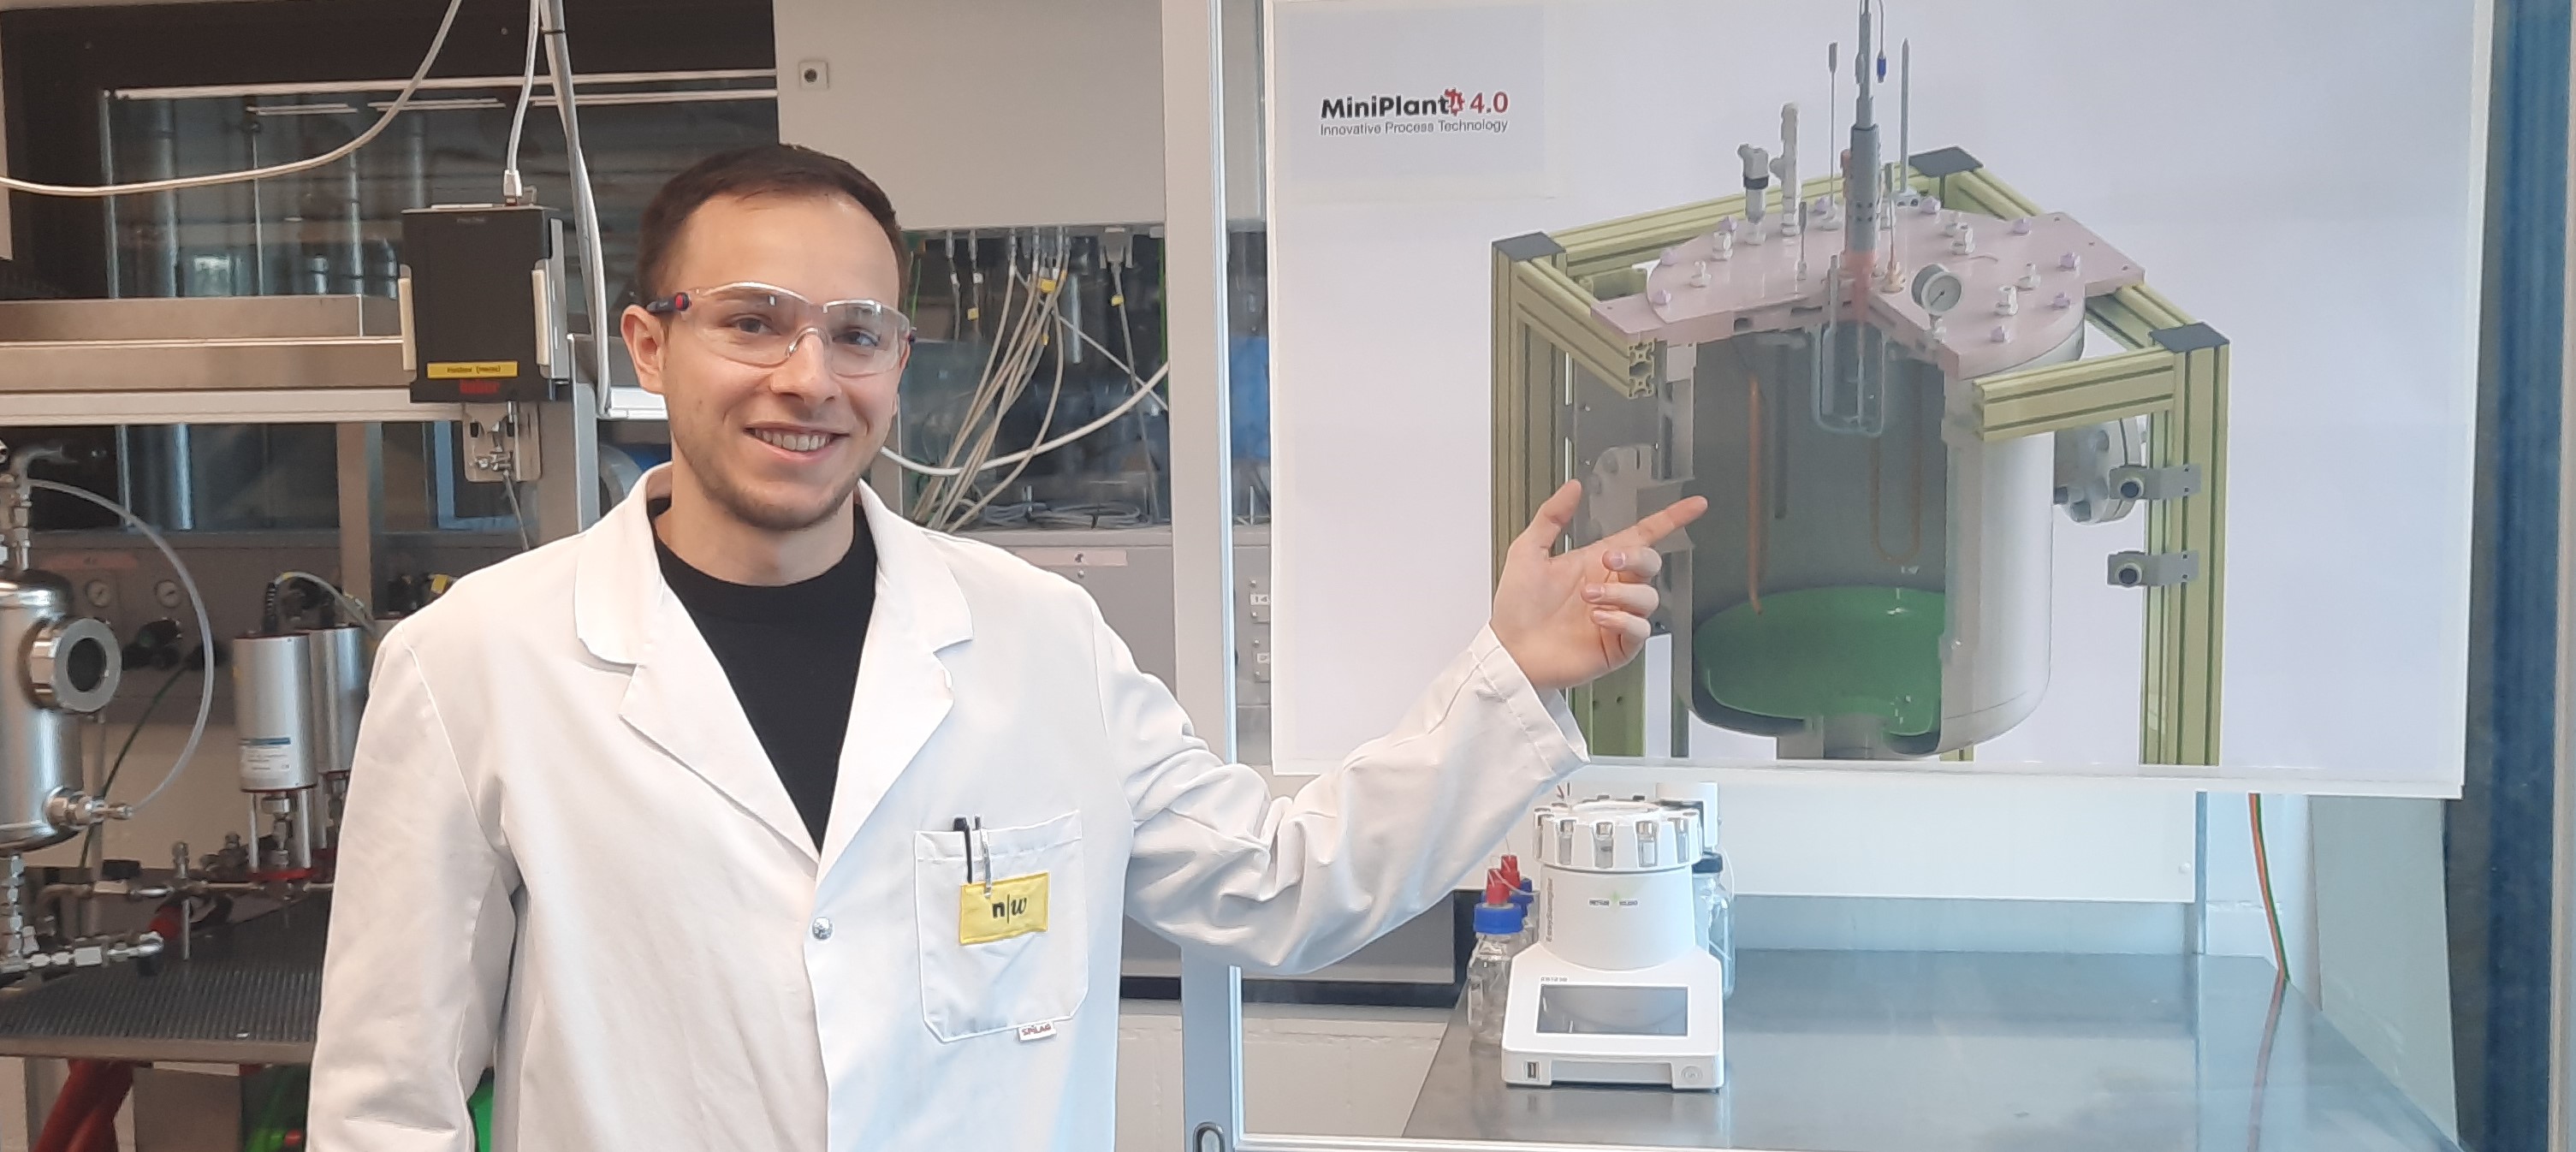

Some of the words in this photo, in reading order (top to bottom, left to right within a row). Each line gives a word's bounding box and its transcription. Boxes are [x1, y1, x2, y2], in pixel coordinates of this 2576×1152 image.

[1321, 94, 1449, 119] MiniPlant
[1469, 91, 1509, 114] 4.0
[1320, 123, 1381, 136] Innovative
[1385, 122, 1433, 134] Process
[1438, 119, 1508, 133] Technology
